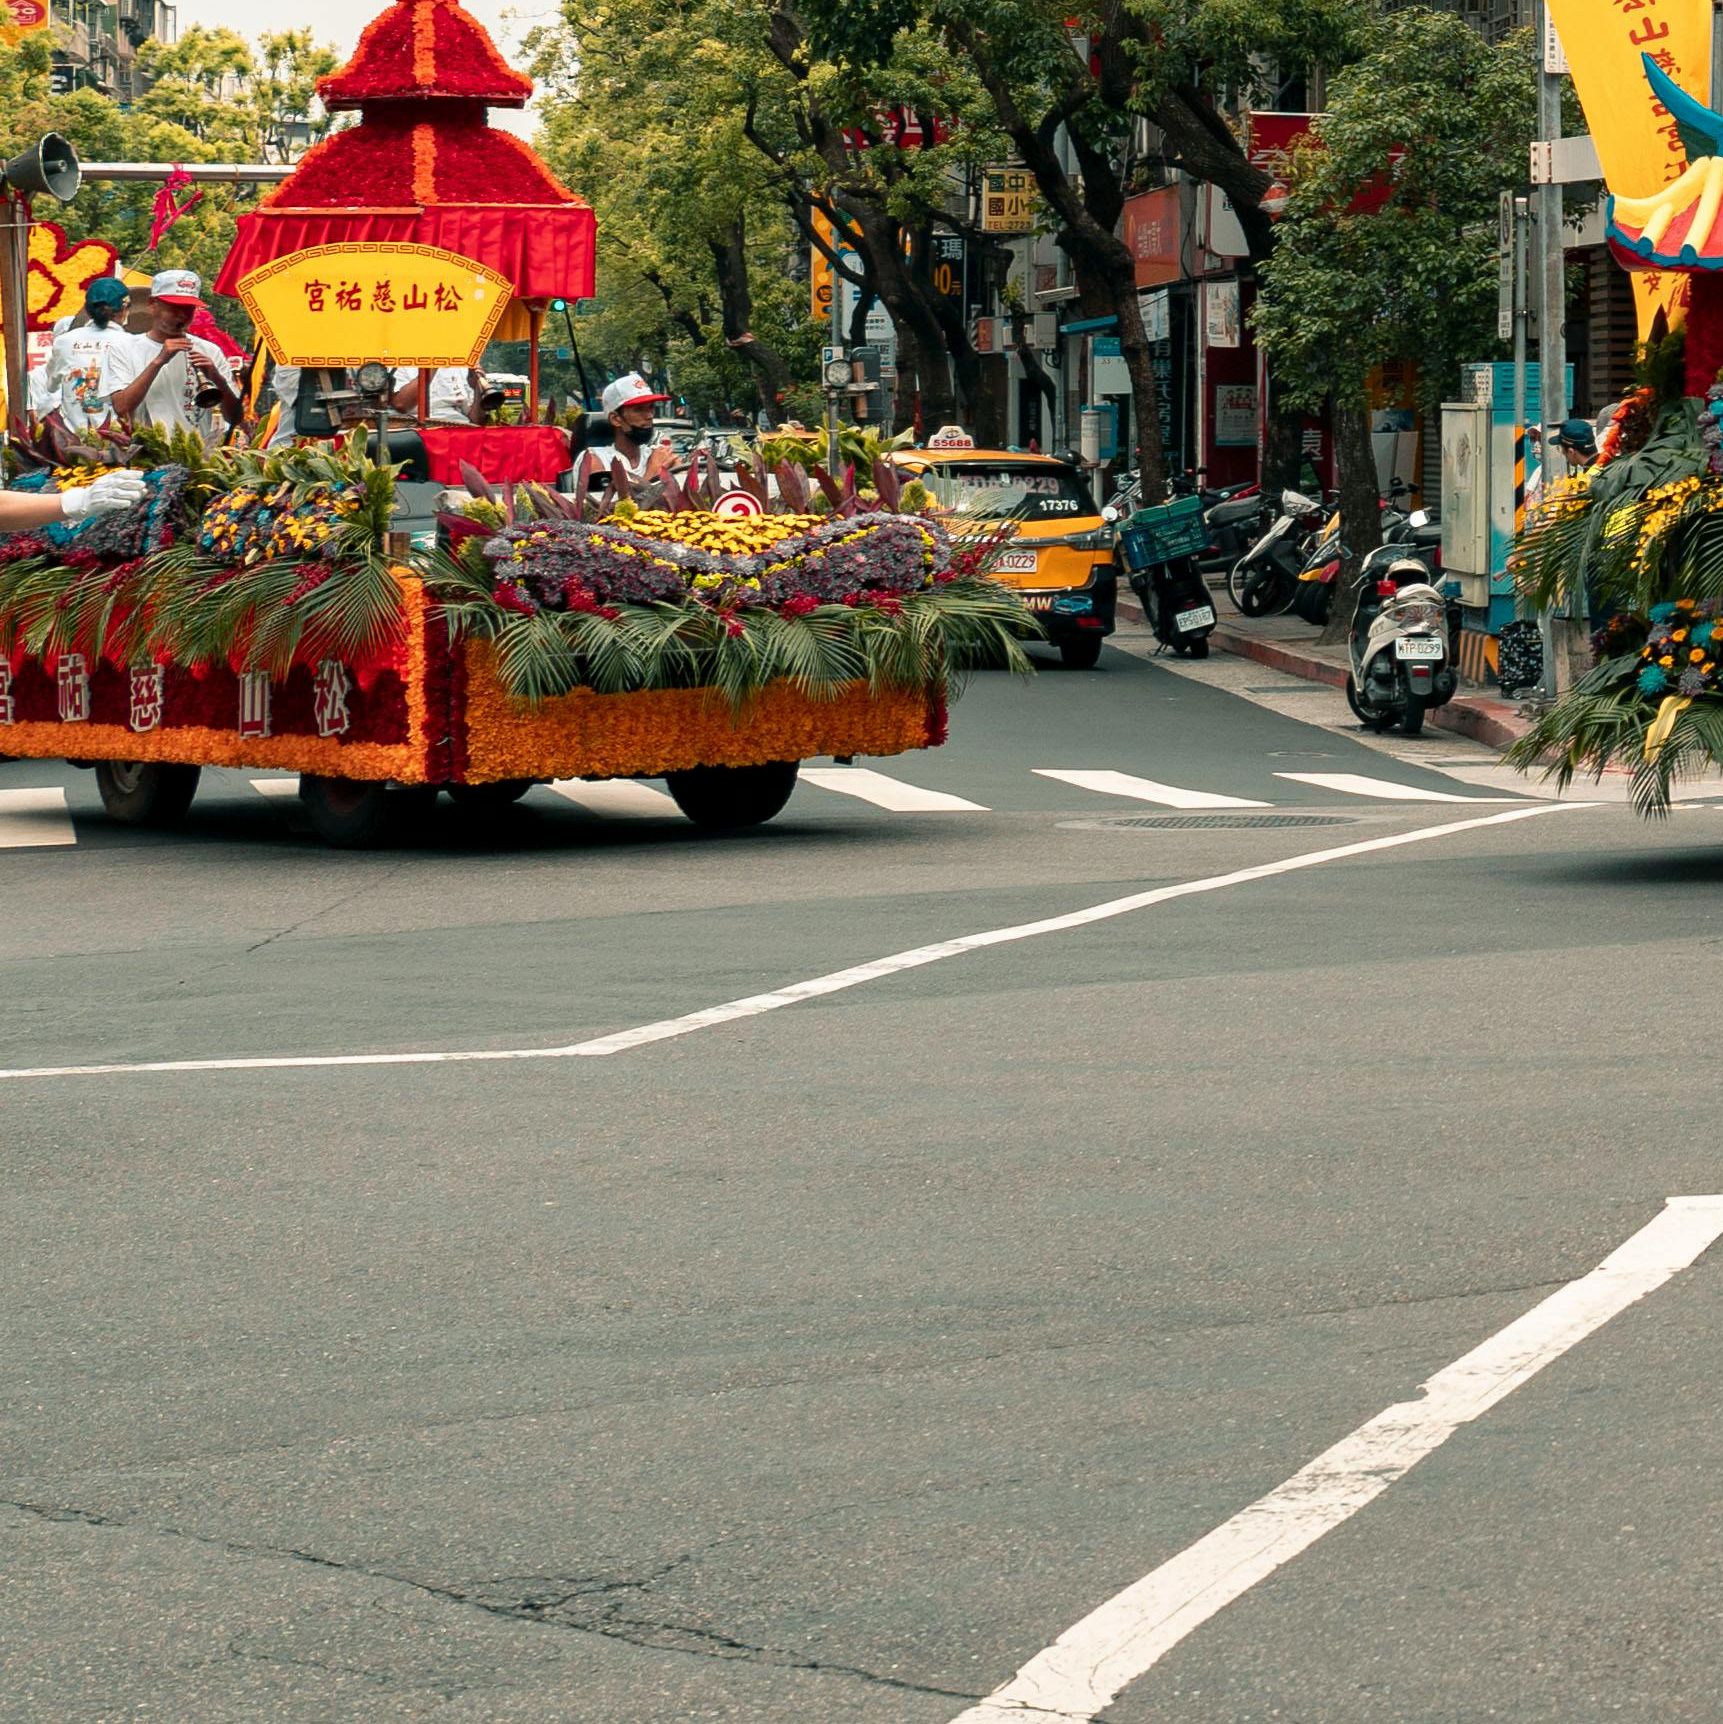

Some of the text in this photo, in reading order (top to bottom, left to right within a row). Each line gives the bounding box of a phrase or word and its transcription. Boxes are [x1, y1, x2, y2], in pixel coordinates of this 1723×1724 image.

[304, 279, 463, 313] 松山慈祐宮
[933, 439, 972, 448] 55688
[1039, 499, 1079, 511] 17376
